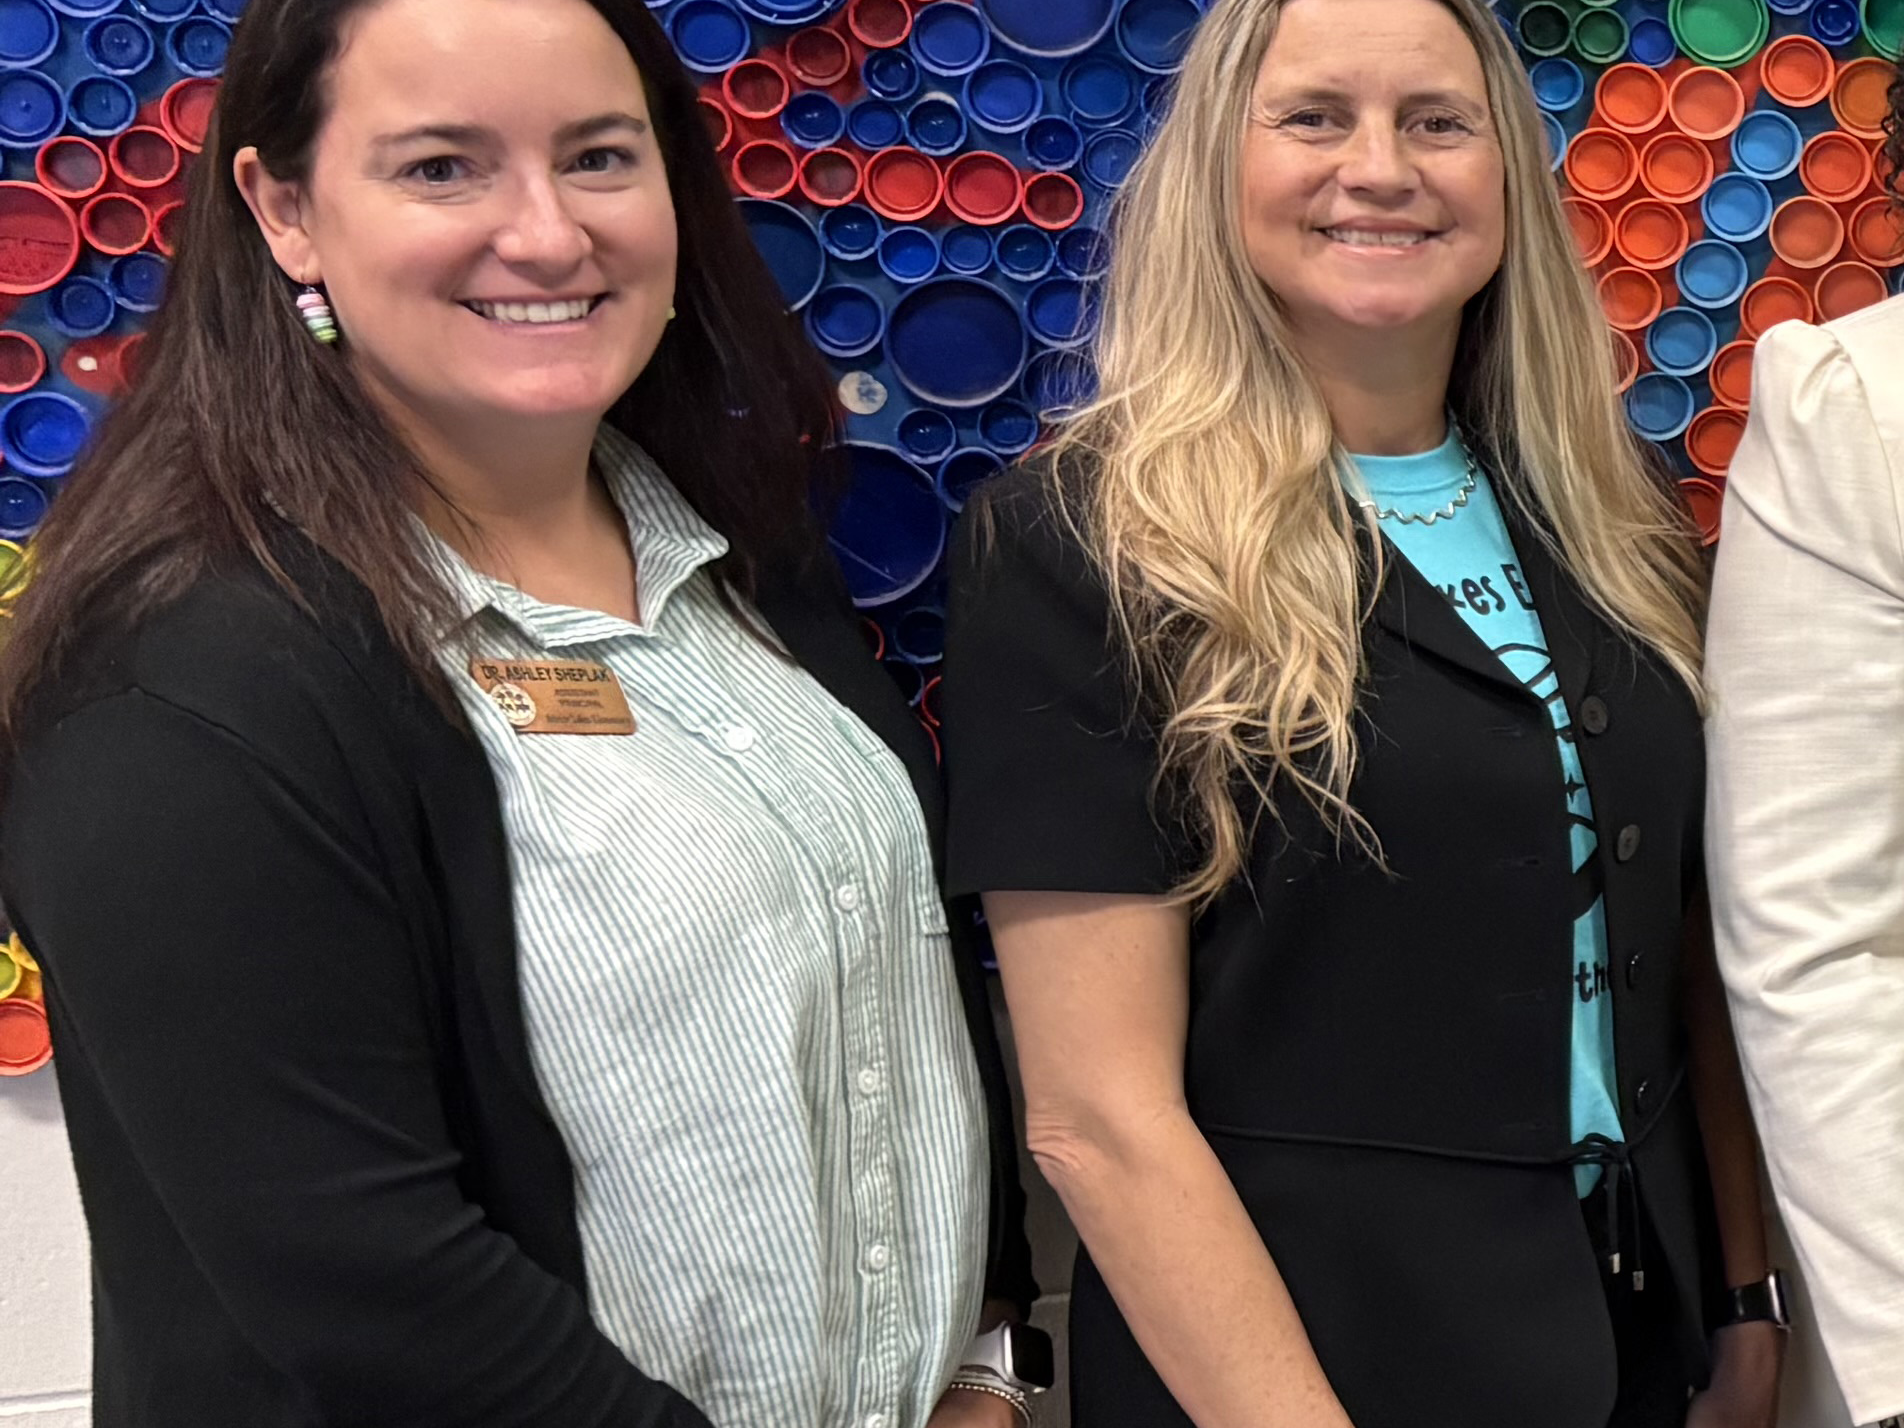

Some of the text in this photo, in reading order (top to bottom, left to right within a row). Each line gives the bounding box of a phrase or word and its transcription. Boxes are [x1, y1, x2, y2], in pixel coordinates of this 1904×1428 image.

[1435, 564, 1536, 615] kes E
[505, 666, 551, 681] ASHLEY
[554, 668, 610, 682] SHEPLAK
